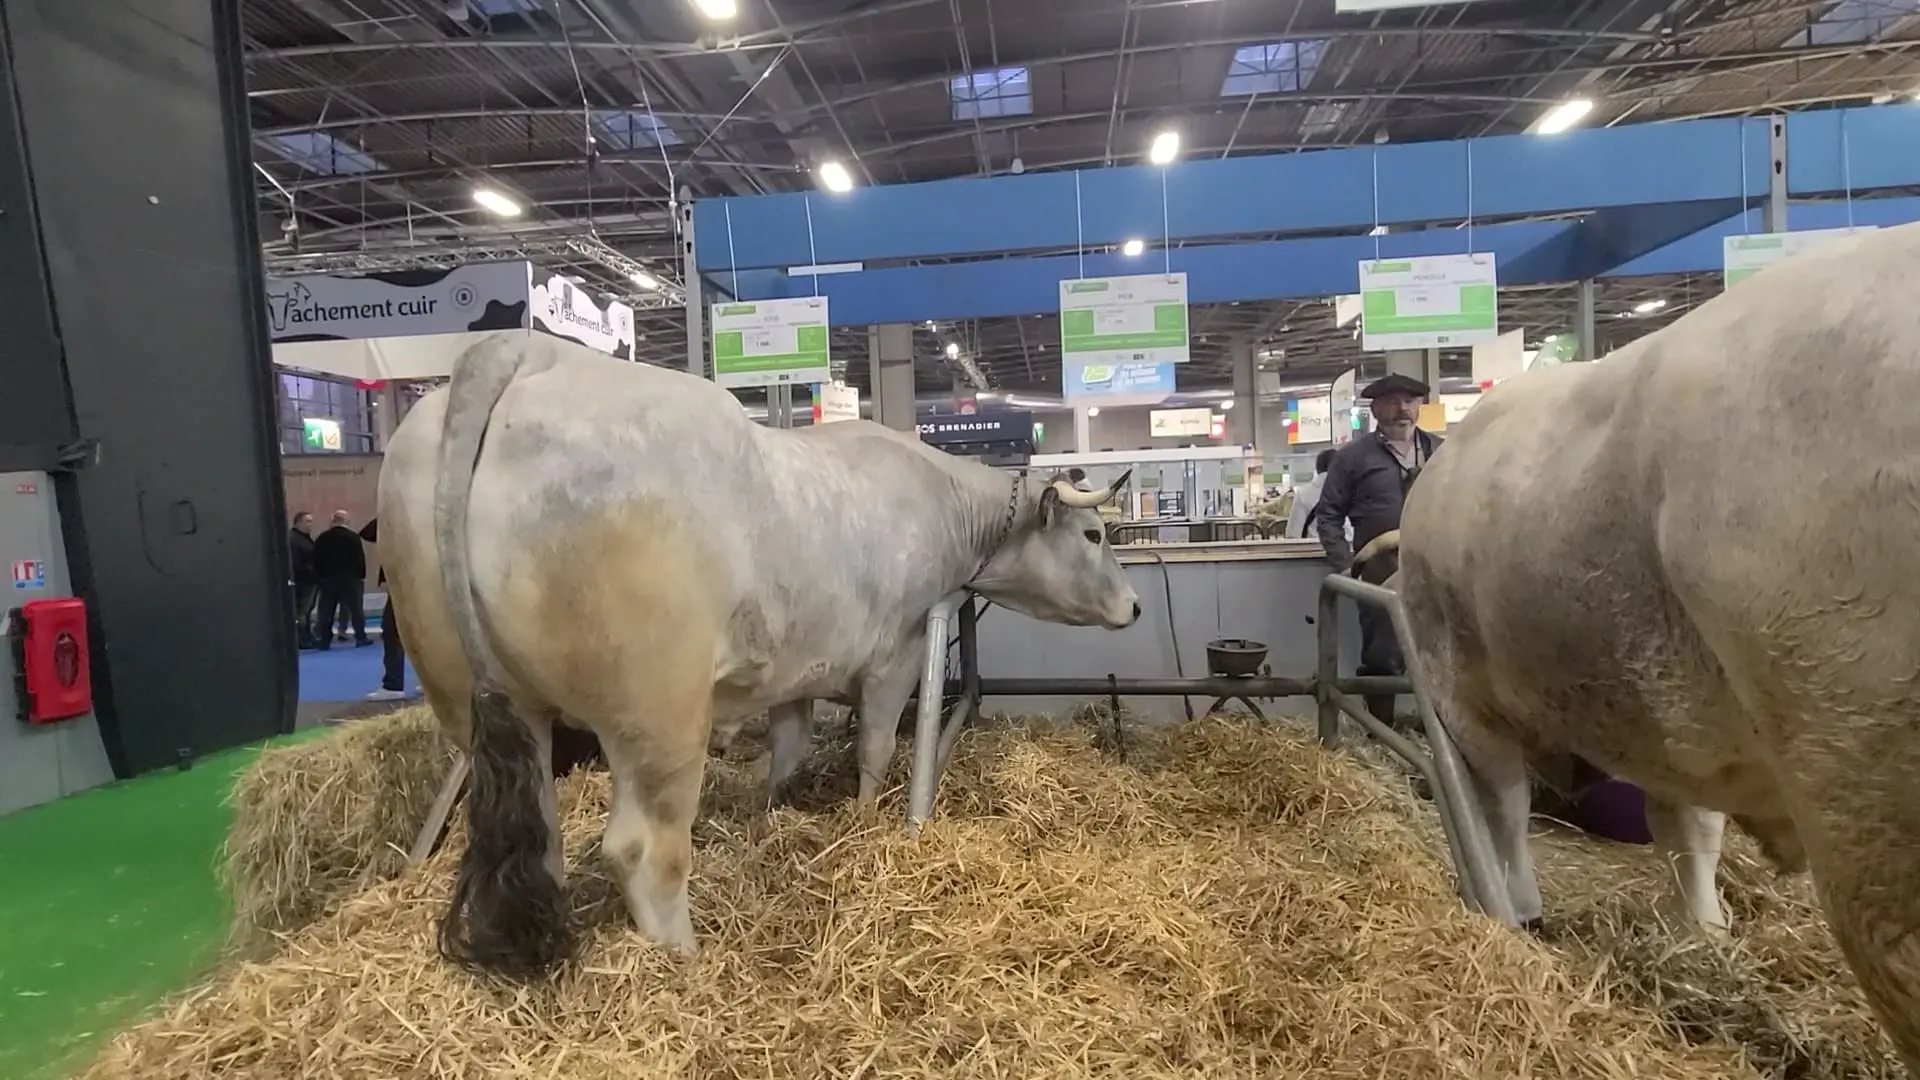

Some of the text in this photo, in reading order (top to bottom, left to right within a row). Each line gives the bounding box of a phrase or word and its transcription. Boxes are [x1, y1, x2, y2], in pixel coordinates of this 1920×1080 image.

[394, 295, 437, 316] cuir
[939, 421, 1001, 432] GRENADIER
[1301, 415, 1321, 427] Ring
